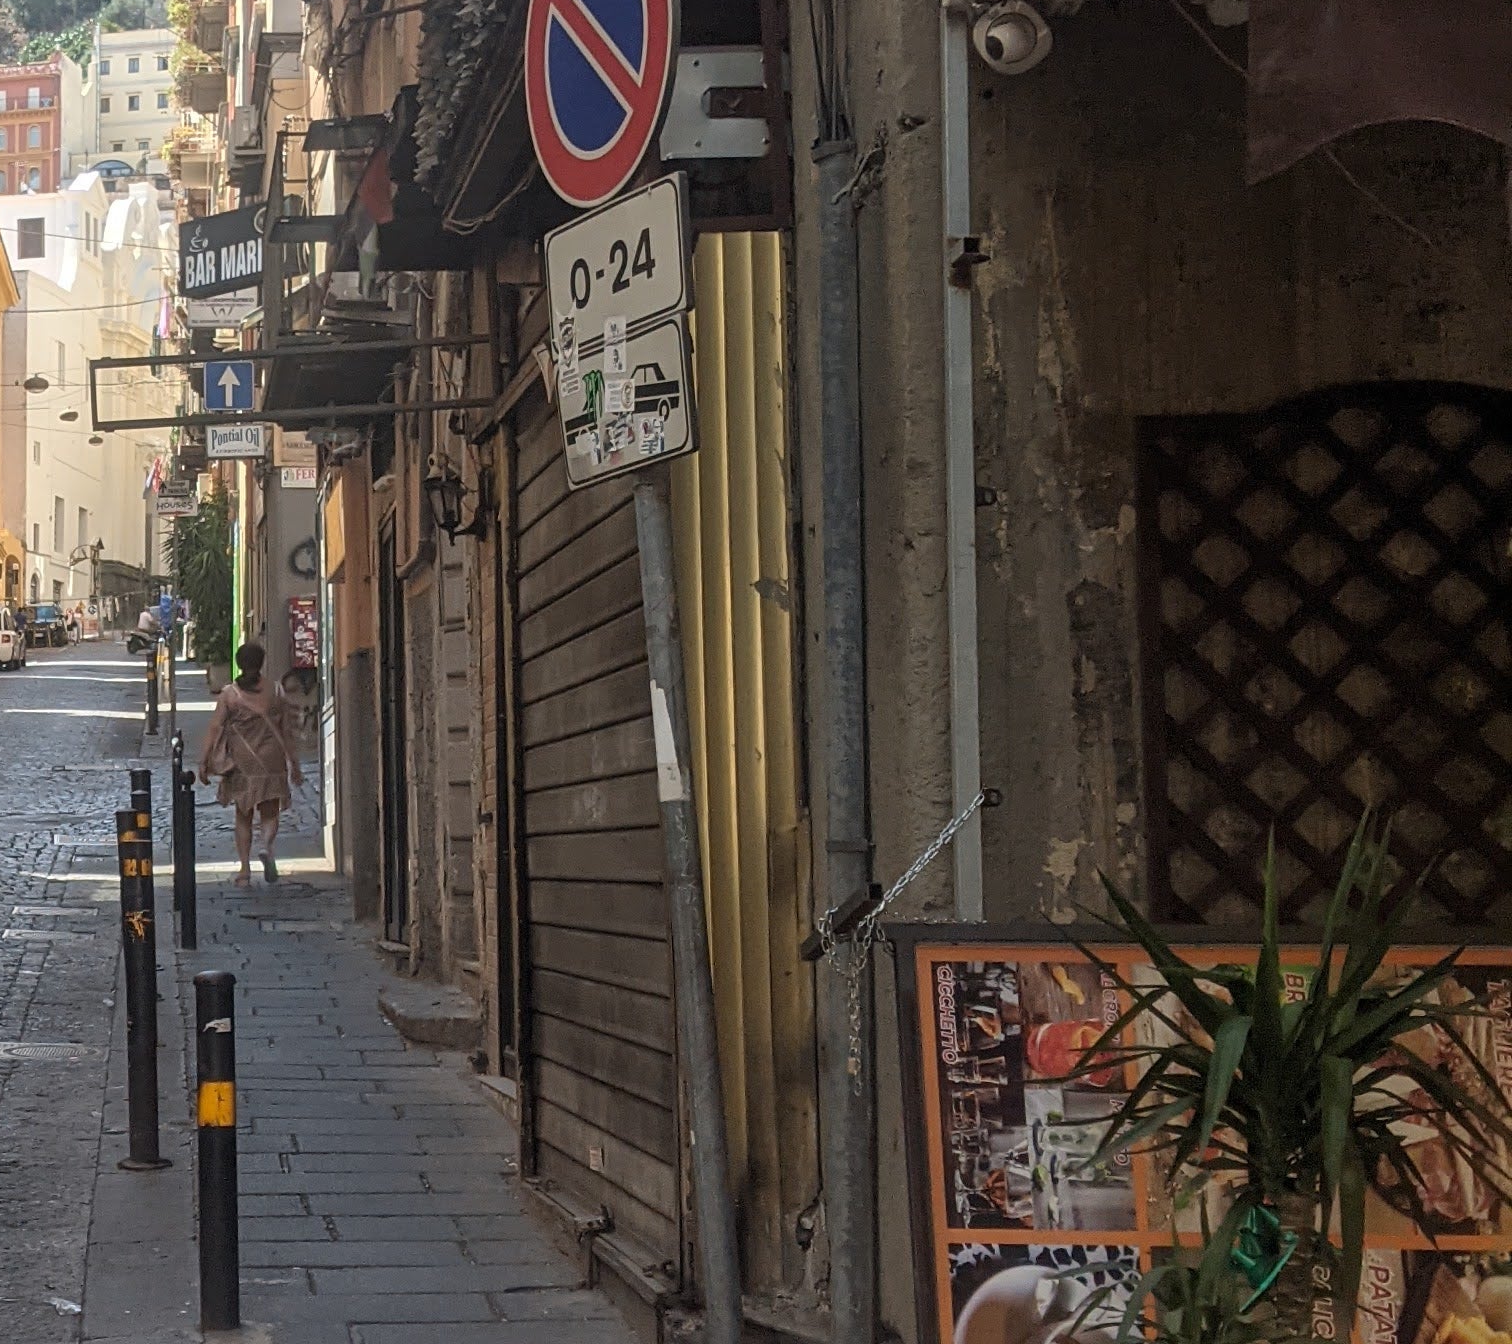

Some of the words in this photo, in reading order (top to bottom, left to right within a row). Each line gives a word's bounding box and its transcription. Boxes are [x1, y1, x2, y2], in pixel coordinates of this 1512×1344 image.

[185, 250, 216, 289] BAR
[220, 237, 263, 281] MARI
[245, 428, 259, 447] Oil
[937, 966, 959, 1065] CICCHETTO
